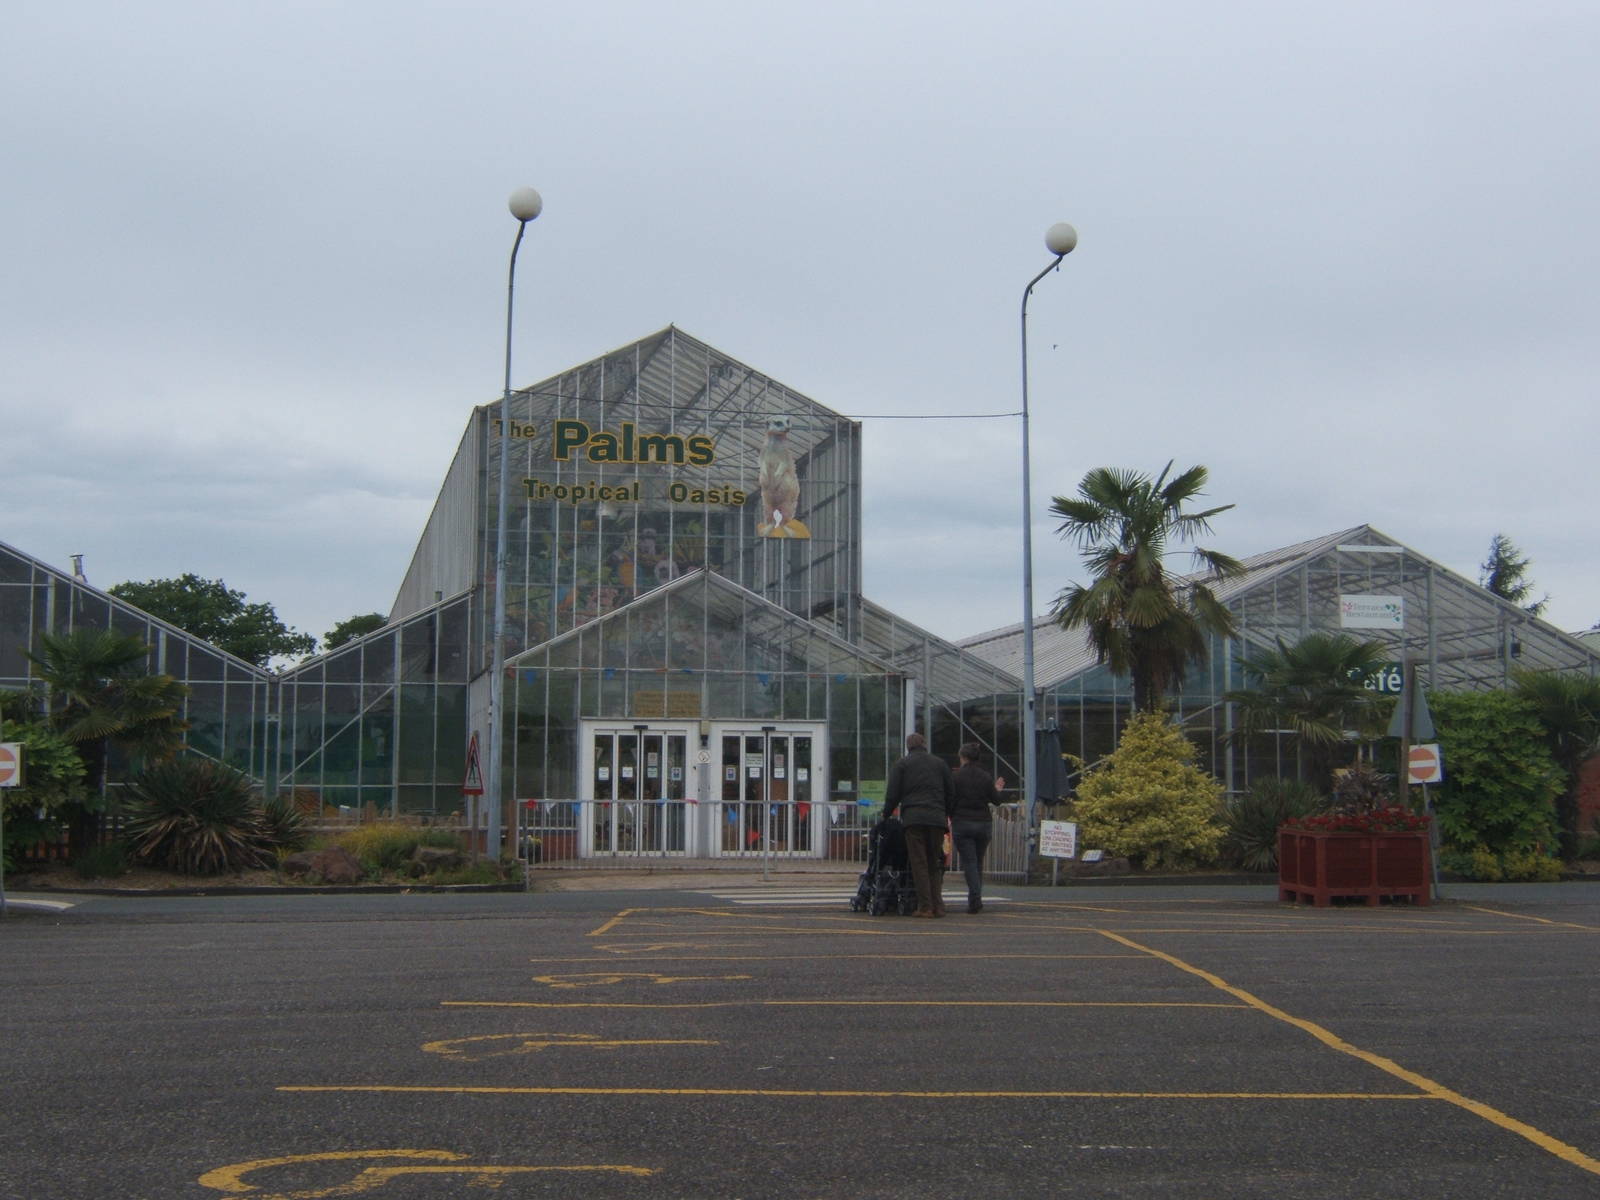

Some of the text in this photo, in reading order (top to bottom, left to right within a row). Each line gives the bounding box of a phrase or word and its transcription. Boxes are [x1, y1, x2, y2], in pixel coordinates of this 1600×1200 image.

[492, 419, 715, 466] The Palms
[523, 478, 746, 505] Tropical Oasis
